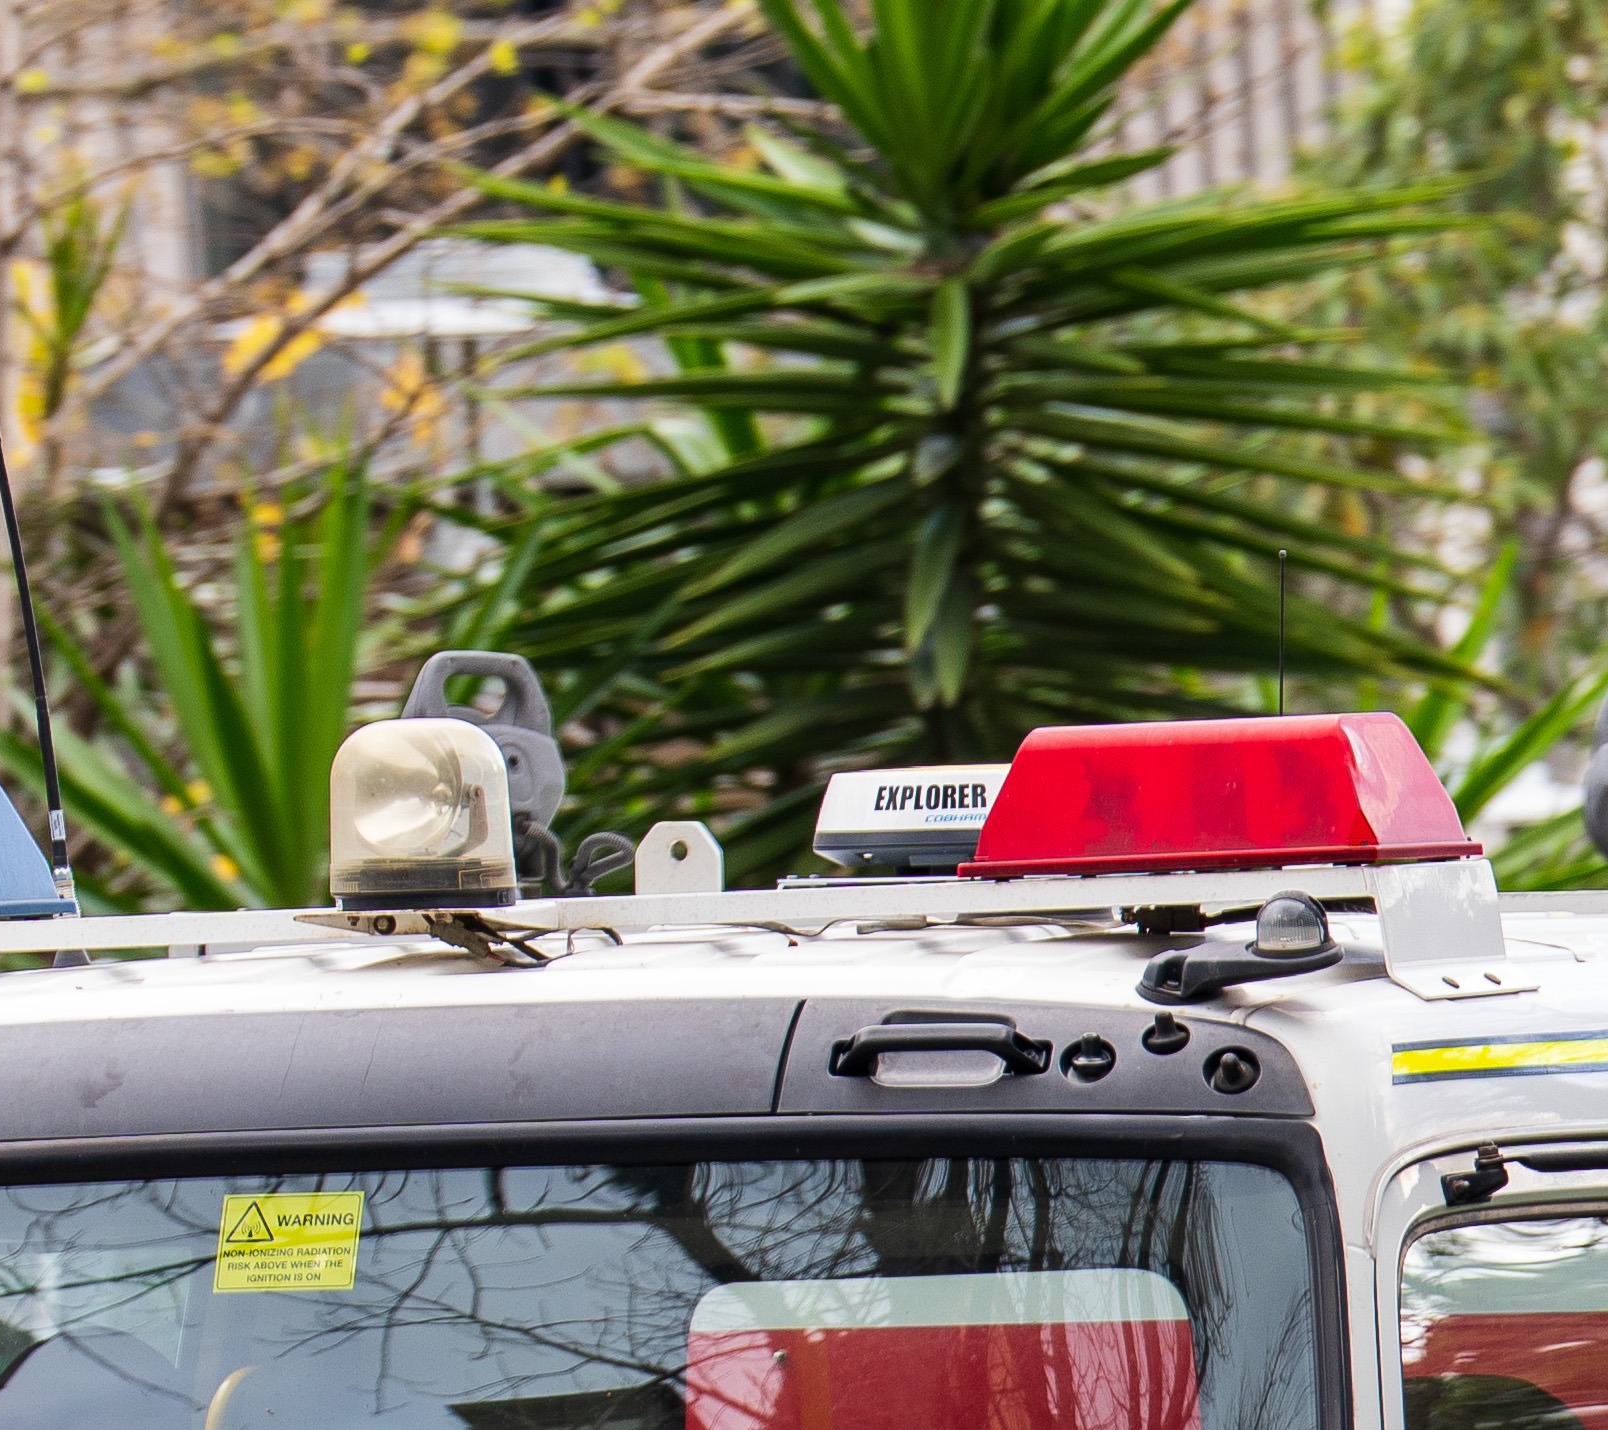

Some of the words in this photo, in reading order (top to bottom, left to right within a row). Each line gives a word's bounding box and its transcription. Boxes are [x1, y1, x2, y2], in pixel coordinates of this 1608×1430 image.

[874, 783, 987, 811] EXPLORER
[277, 1213, 355, 1227] WARNING
[222, 1248, 294, 1258] NON-IONIZING
[296, 1246, 351, 1256] RADIATION
[227, 1261, 251, 1270] RISK
[253, 1260, 288, 1270] ABOVE
[291, 1259, 321, 1269] WHEN
[324, 1259, 343, 1268] THE
[246, 1273, 292, 1283] IGNITION
[294, 1273, 303, 1281] IS
[306, 1272, 322, 1281] ON
